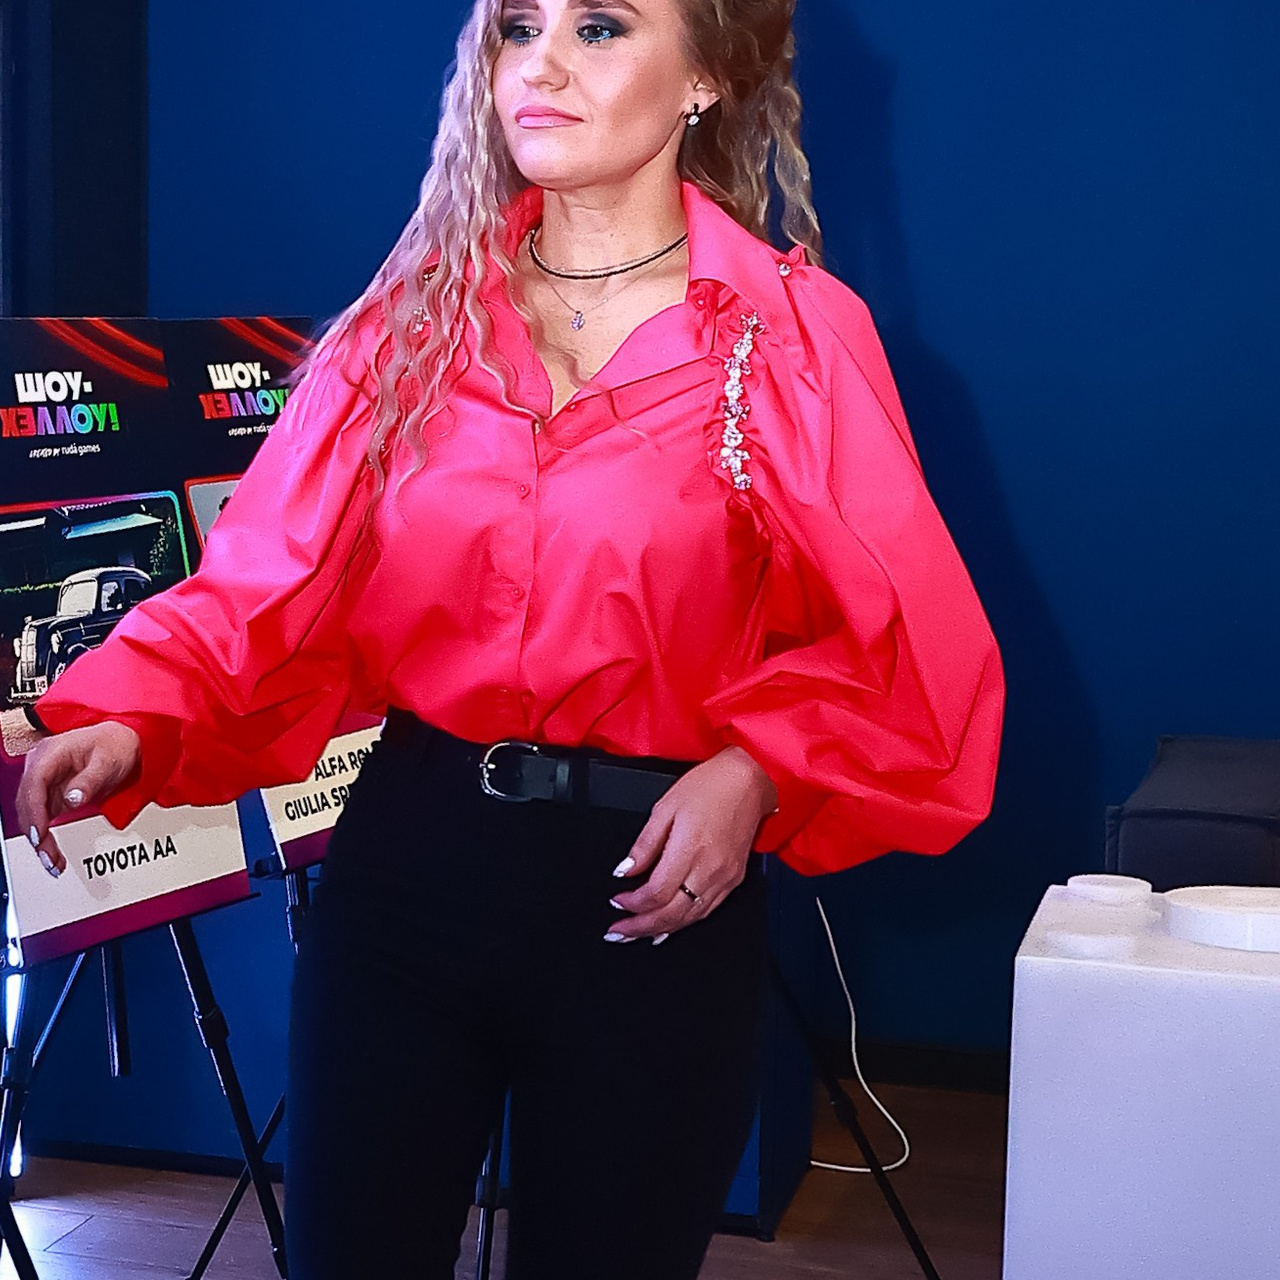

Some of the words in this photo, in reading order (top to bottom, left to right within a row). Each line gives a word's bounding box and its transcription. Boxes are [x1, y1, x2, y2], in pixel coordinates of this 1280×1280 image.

[14, 371, 93, 403] ШОУ-
[207, 362, 271, 390] ШОУ-
[314, 754, 349, 782] ALFA
[347, 747, 373, 770] RO
[284, 791, 331, 821] GIULIA
[82, 842, 150, 880] TOYOTA
[153, 835, 178, 861] AA
